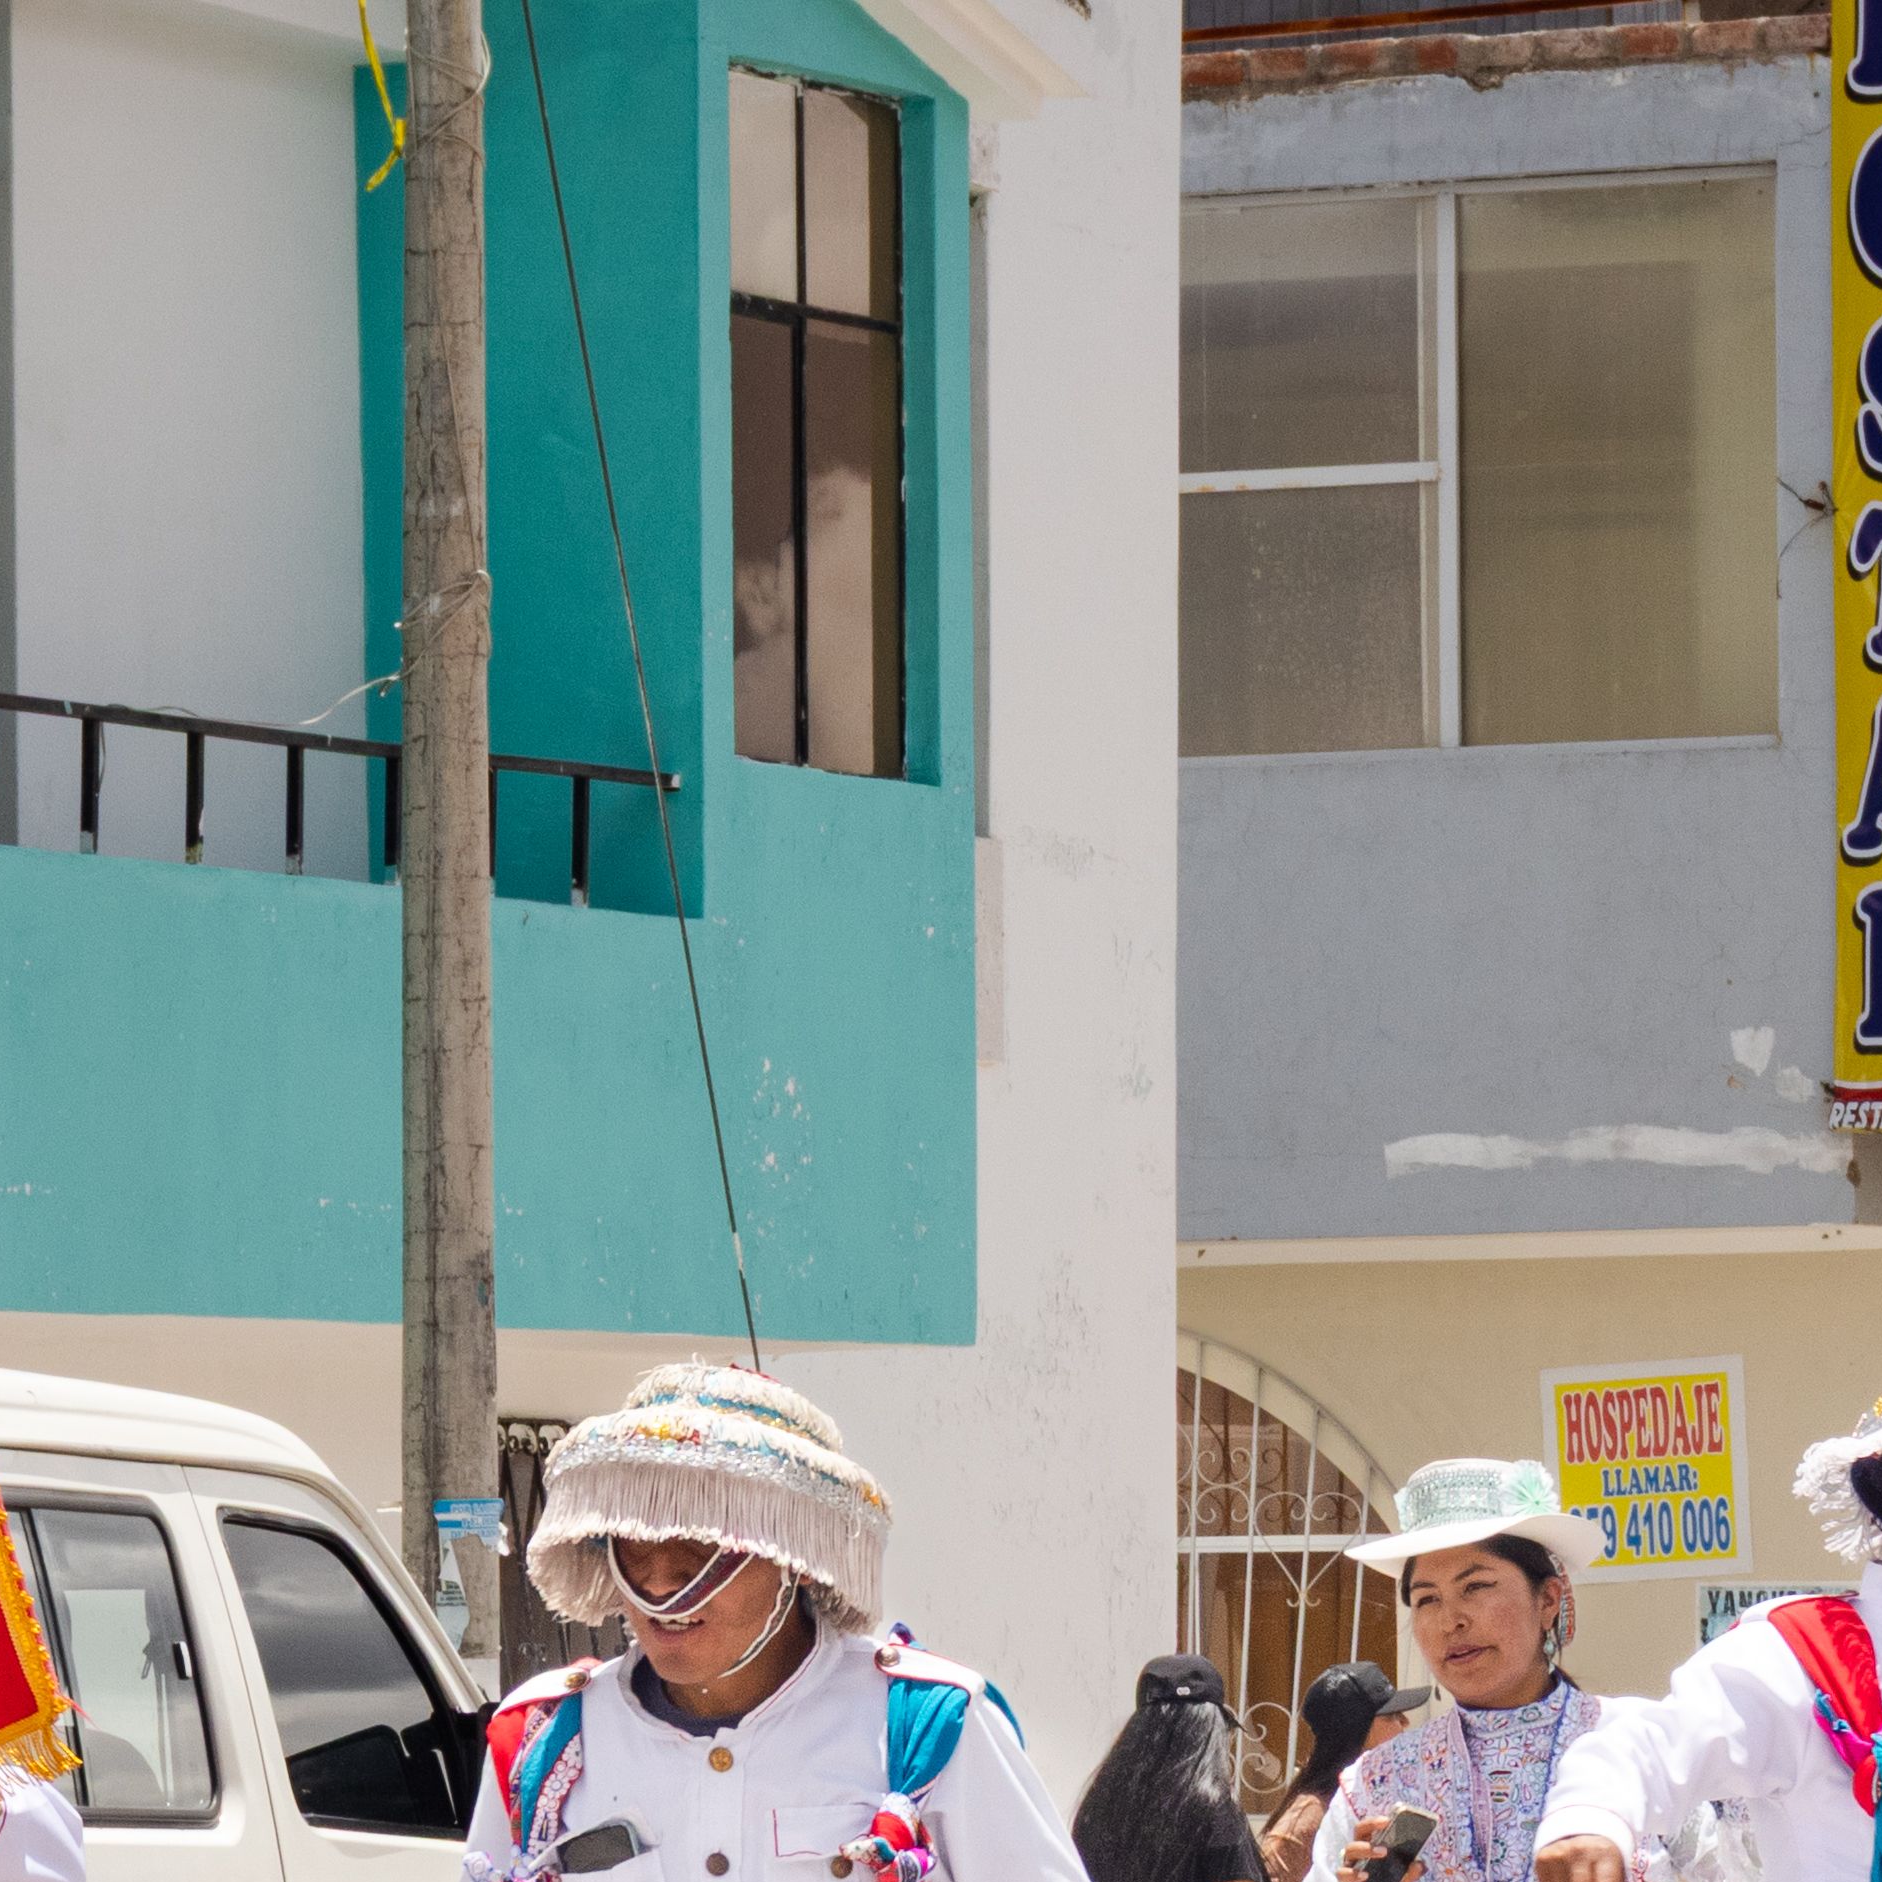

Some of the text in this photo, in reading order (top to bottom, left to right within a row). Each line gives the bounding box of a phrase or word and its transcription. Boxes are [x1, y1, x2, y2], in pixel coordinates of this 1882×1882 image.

[1563, 1382, 1723, 1463] HOSPEDAJE
[1602, 1464, 1698, 1497] LLAMAR:
[1626, 1501, 1674, 1556] 410
[1682, 1497, 1730, 1554] 006
